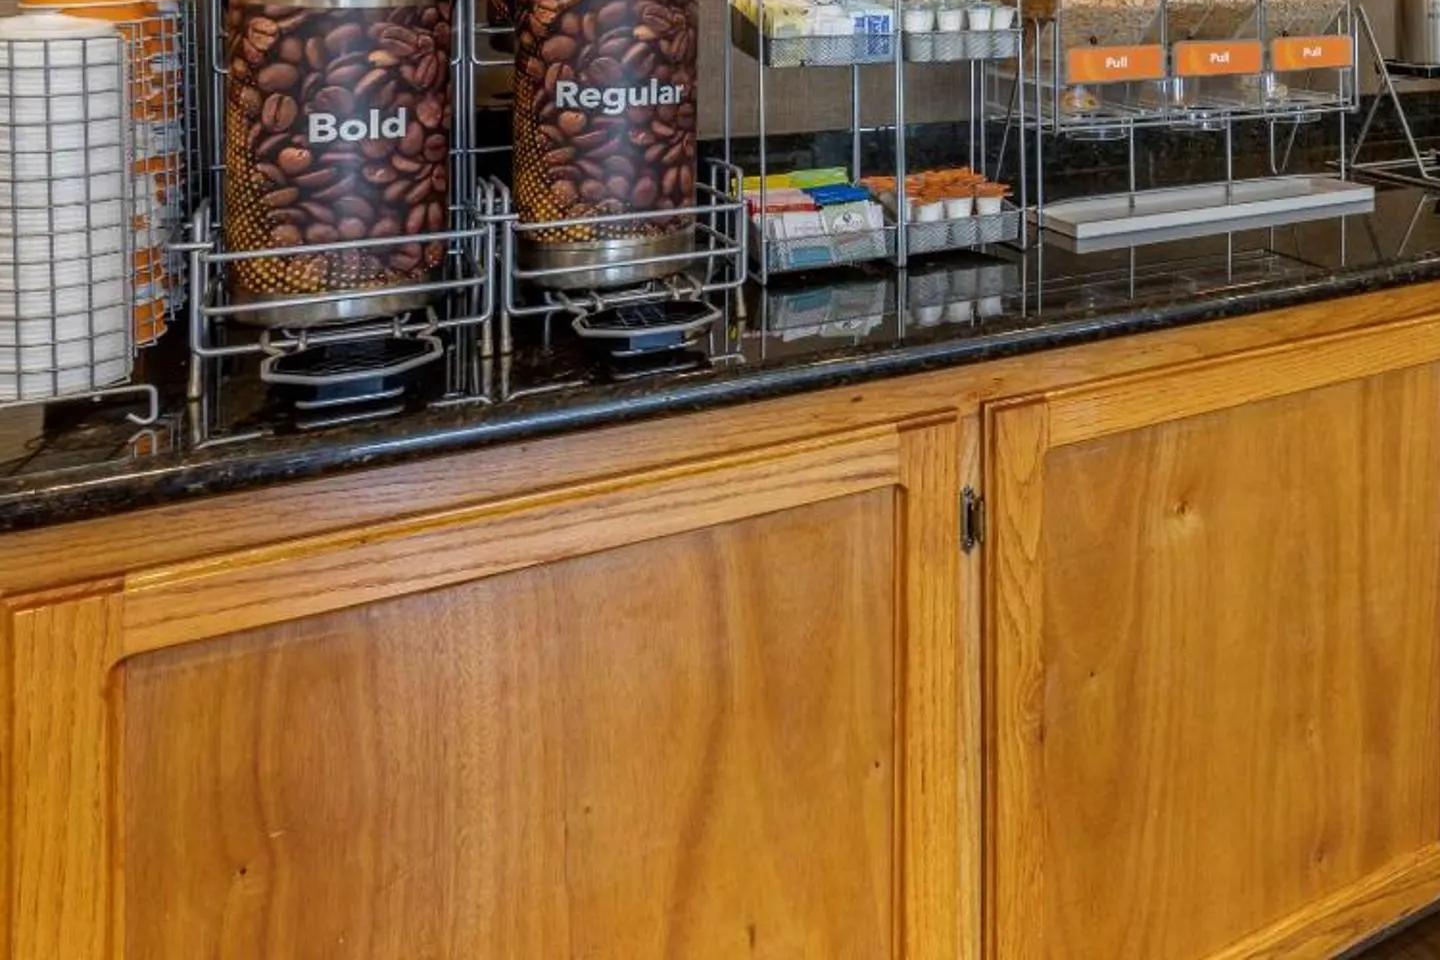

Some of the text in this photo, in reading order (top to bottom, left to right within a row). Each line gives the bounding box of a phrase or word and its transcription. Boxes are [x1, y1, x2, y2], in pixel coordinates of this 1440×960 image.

[1209, 52, 1230, 63] Pull
[1303, 47, 1322, 57] Pull
[1105, 56, 1128, 68] Pull
[556, 78, 685, 115] Regular
[308, 107, 406, 143] Bold
